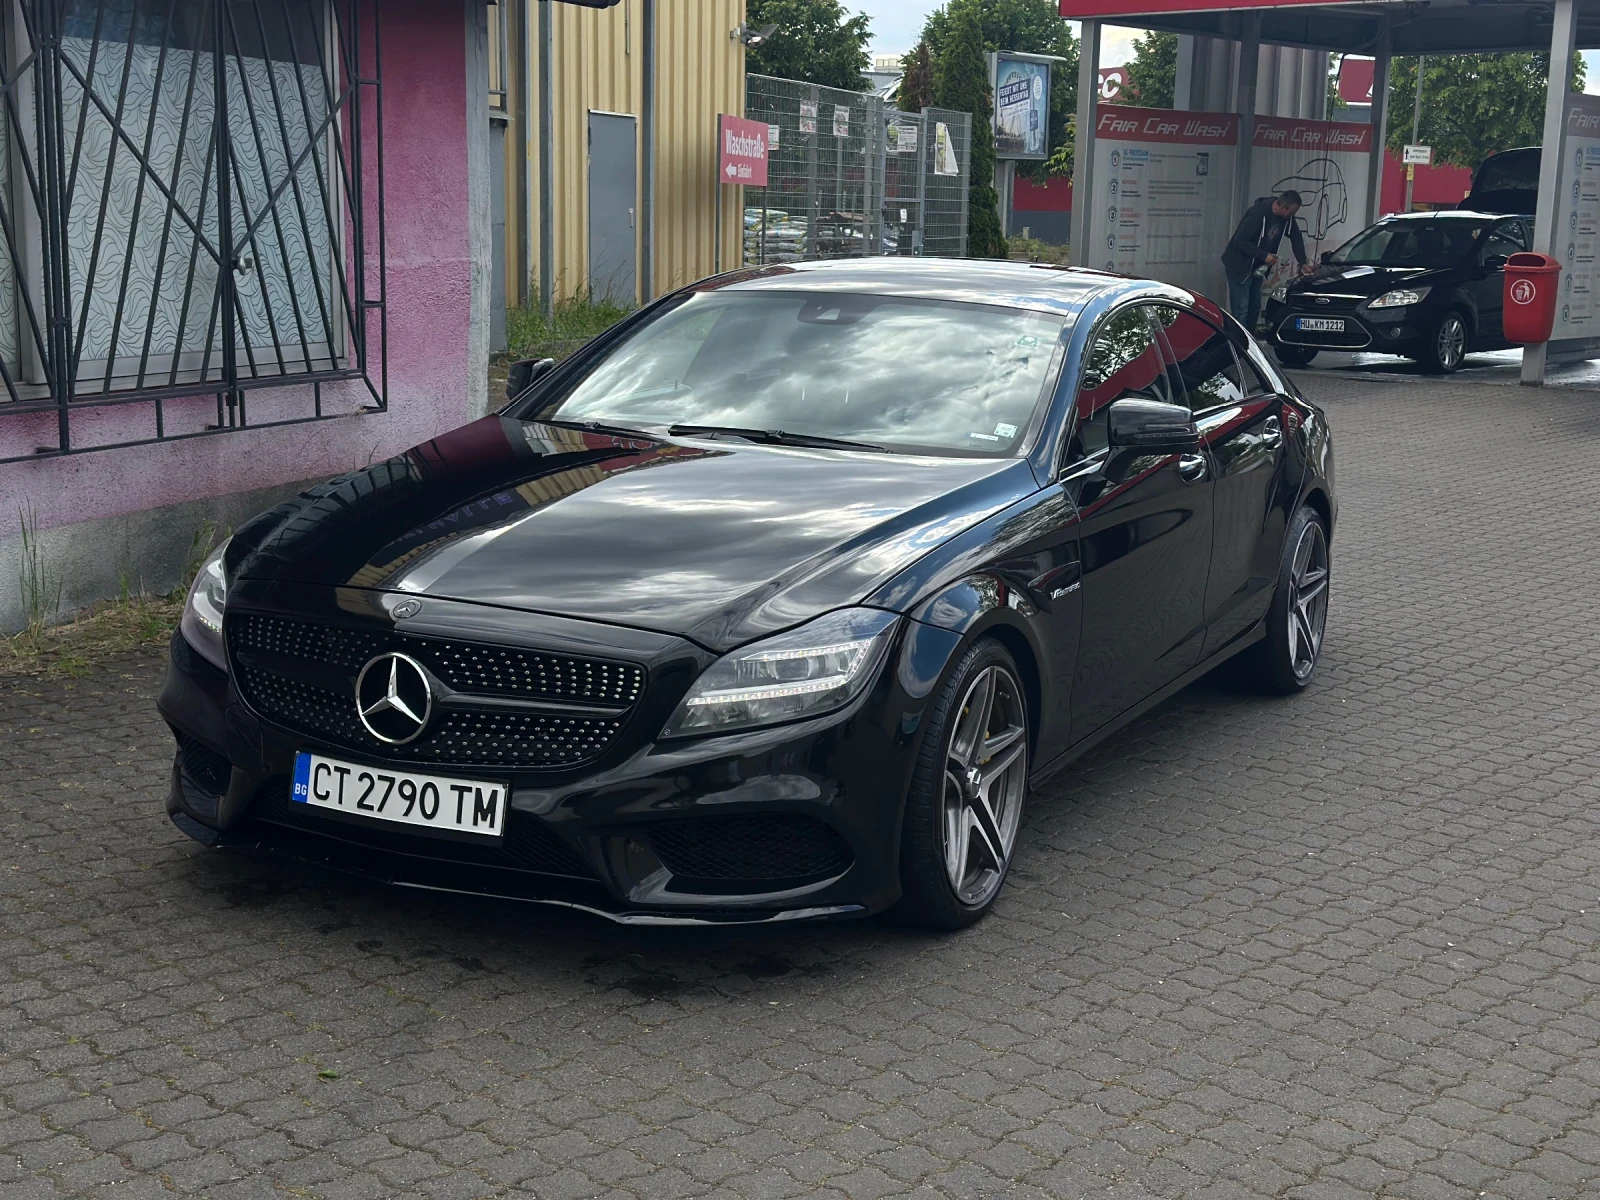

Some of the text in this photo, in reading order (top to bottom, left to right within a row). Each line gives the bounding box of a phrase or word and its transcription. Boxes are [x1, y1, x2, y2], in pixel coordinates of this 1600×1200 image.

[725, 129, 765, 159] Waschstraße
[1300, 319, 1344, 331] HU KM 1212
[294, 782, 308, 796] BG
[312, 762, 499, 829] CT 2790 TM
